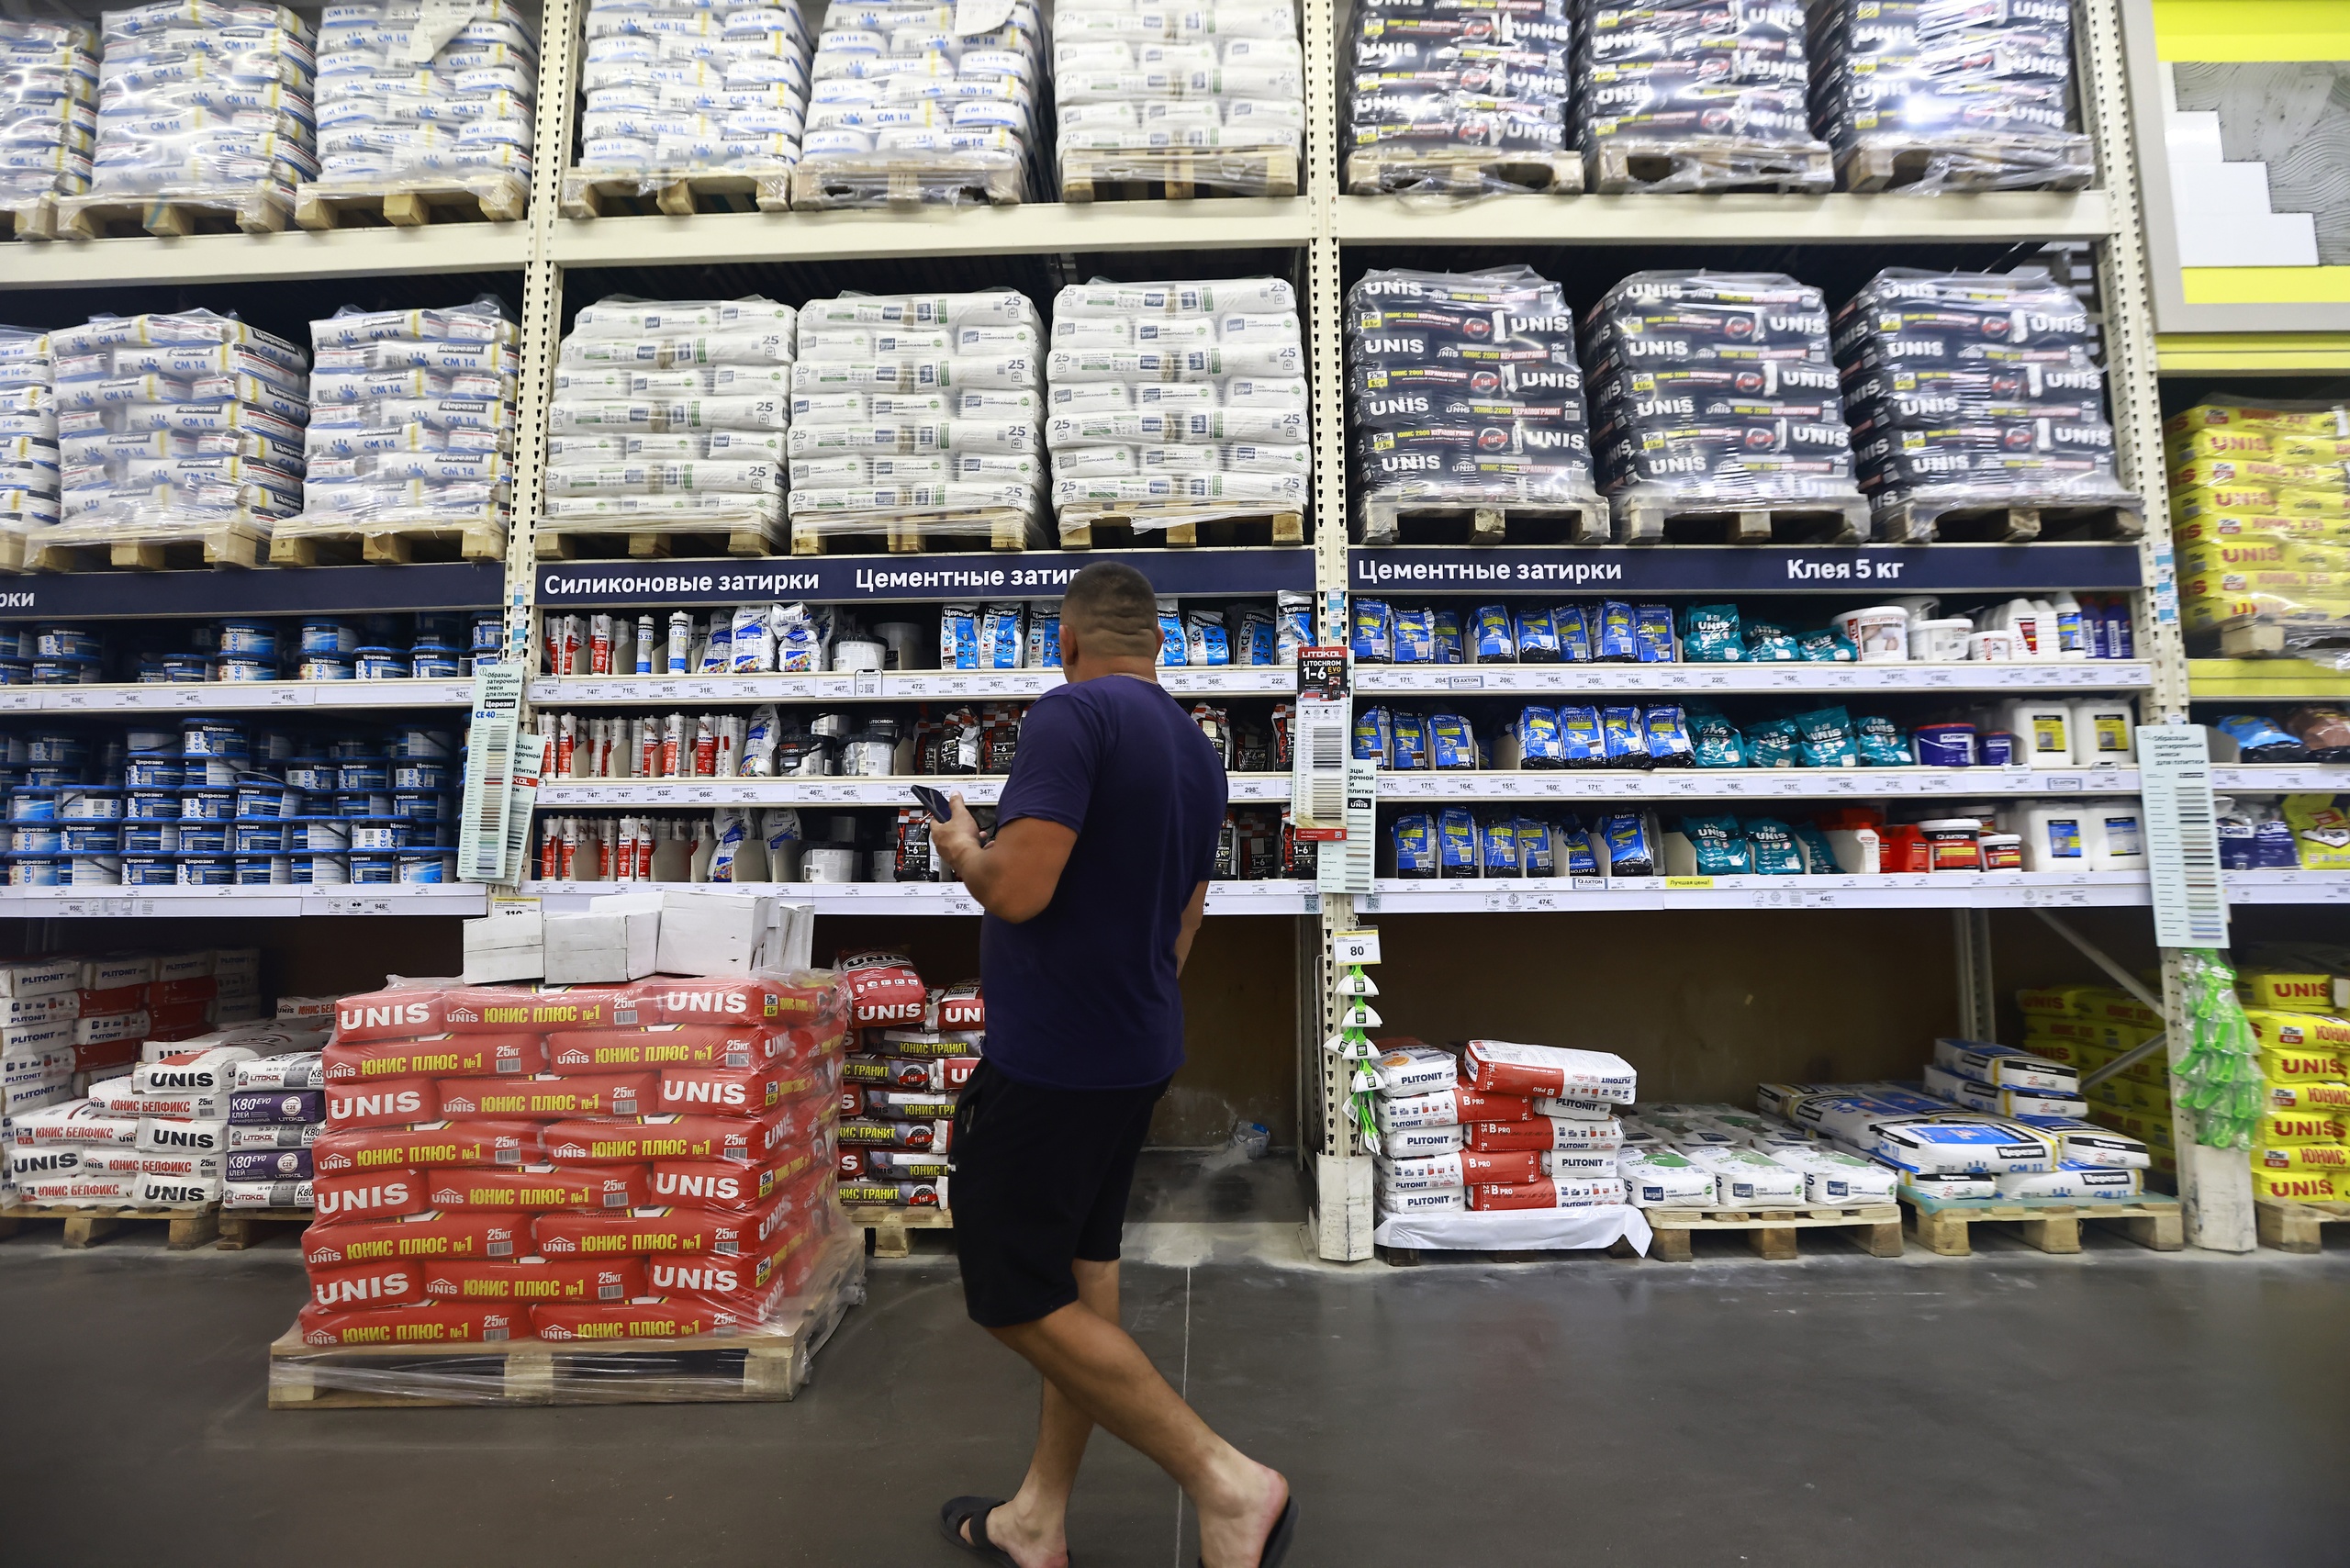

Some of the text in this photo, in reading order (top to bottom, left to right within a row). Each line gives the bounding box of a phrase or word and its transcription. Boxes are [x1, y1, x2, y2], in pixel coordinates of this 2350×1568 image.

[1365, 282, 1424, 297] UNIS
[1511, 316, 1569, 331] UNIS
[1770, 316, 1827, 333] UNIS
[2031, 316, 2087, 332] UNIS
[1364, 339, 1425, 353] UNIS
[1628, 341, 1688, 356] UNIS
[464, 358, 476, 367] 14
[1008, 360, 1025, 369] 25
[1522, 373, 1580, 389] UNIS
[1783, 371, 1839, 389] UNIS
[2046, 373, 2101, 389] UNIS
[756, 402, 773, 411] 25
[1370, 397, 1429, 416] UNIS
[1446, 404, 1471, 413] UNIS
[1637, 398, 1694, 418] UNIS
[1283, 414, 1300, 424] 25
[1527, 431, 1585, 449] UNIS
[1792, 426, 1849, 447] UNIS
[383, 440, 396, 448] 14
[749, 466, 767, 476] 25
[1382, 455, 1440, 473] UNIS
[1359, 560, 1622, 585] Цементные затирки
[1786, 558, 1904, 579] Клея 5 кг
[544, 574, 819, 596] Силиконовые затирки
[855, 567, 1005, 592] Цементные
[1304, 667, 1326, 679] 1-6
[904, 846, 919, 855] 1-6
[1350, 946, 1364, 956] 80
[22, 973, 64, 985] PLITONIT
[2274, 982, 2329, 997] UNIS
[614, 997, 637, 1009] 25кг
[667, 991, 746, 1014] UNIS
[341, 1002, 430, 1030] UNIS
[446, 1013, 479, 1023] UNIS
[484, 1004, 600, 1023] ЮНИС ПЛЮС №1
[857, 1002, 922, 1021] UNIS
[11, 1032, 55, 1044] PLITONIT
[90, 1031, 121, 1040] PLITONIT
[726, 1040, 750, 1051] 25кг
[900, 1042, 968, 1054] ЮНИС ГРАНИТ
[557, 1054, 589, 1064] UNIS
[595, 1045, 712, 1063] ЮНИС ПЛЮС №1
[362, 1052, 482, 1076] ЮНИС ПЛЮС №1
[2282, 1058, 2341, 1074] UNIS
[5, 1072, 41, 1083] PLITONIT
[325, 1067, 356, 1079] UNIS
[854, 1066, 889, 1077] ГРАНИТ
[1401, 1071, 1443, 1085] PLITONIT
[150, 1072, 214, 1087] UNIS
[13, 1085, 56, 1102] PLITONIT
[663, 1080, 745, 1105] UNIS
[110, 1100, 191, 1113] ЮНИС БЕЛФИКС
[198, 1098, 213, 1106] 25кг
[231, 1098, 256, 1111] K80
[330, 1091, 420, 1119] UNIS
[1463, 1096, 1484, 1105] B PRO
[1555, 1098, 1597, 1111] PLITONIT
[904, 1104, 934, 1115] ЮНИС
[1391, 1120, 1423, 1128] PLITONIT
[1489, 1124, 1497, 1134] B
[2275, 1121, 2333, 1136] UNIS
[36, 1127, 114, 1138] ЮНИС БЕЛФИКС
[153, 1129, 214, 1148] UNIS
[859, 1128, 896, 1139] ГРАНИТ
[1406, 1136, 1449, 1145] PLITONIT
[1999, 1147, 2043, 1158] Церезит
[2095, 1152, 2106, 1162] 25
[14, 1152, 78, 1173] UNIS
[109, 1159, 192, 1172] ЮНИС БЕЛФИКС
[1561, 1159, 1604, 1167] PLITONIT
[2084, 1173, 2128, 1183] Церезит
[655, 1172, 740, 1199] UNIS
[2271, 1179, 2333, 1197] UNIS
[145, 1184, 205, 1202] UNIS
[318, 1182, 409, 1214] UNIS
[863, 1188, 900, 1200] ГРАНИТ
[1407, 1195, 1449, 1206] PLITONIT
[543, 1242, 576, 1252] UNIS
[581, 1234, 701, 1252] ЮНИС ПЛЮС №1
[653, 1265, 738, 1292] UNIS
[316, 1272, 409, 1305] UNIS
